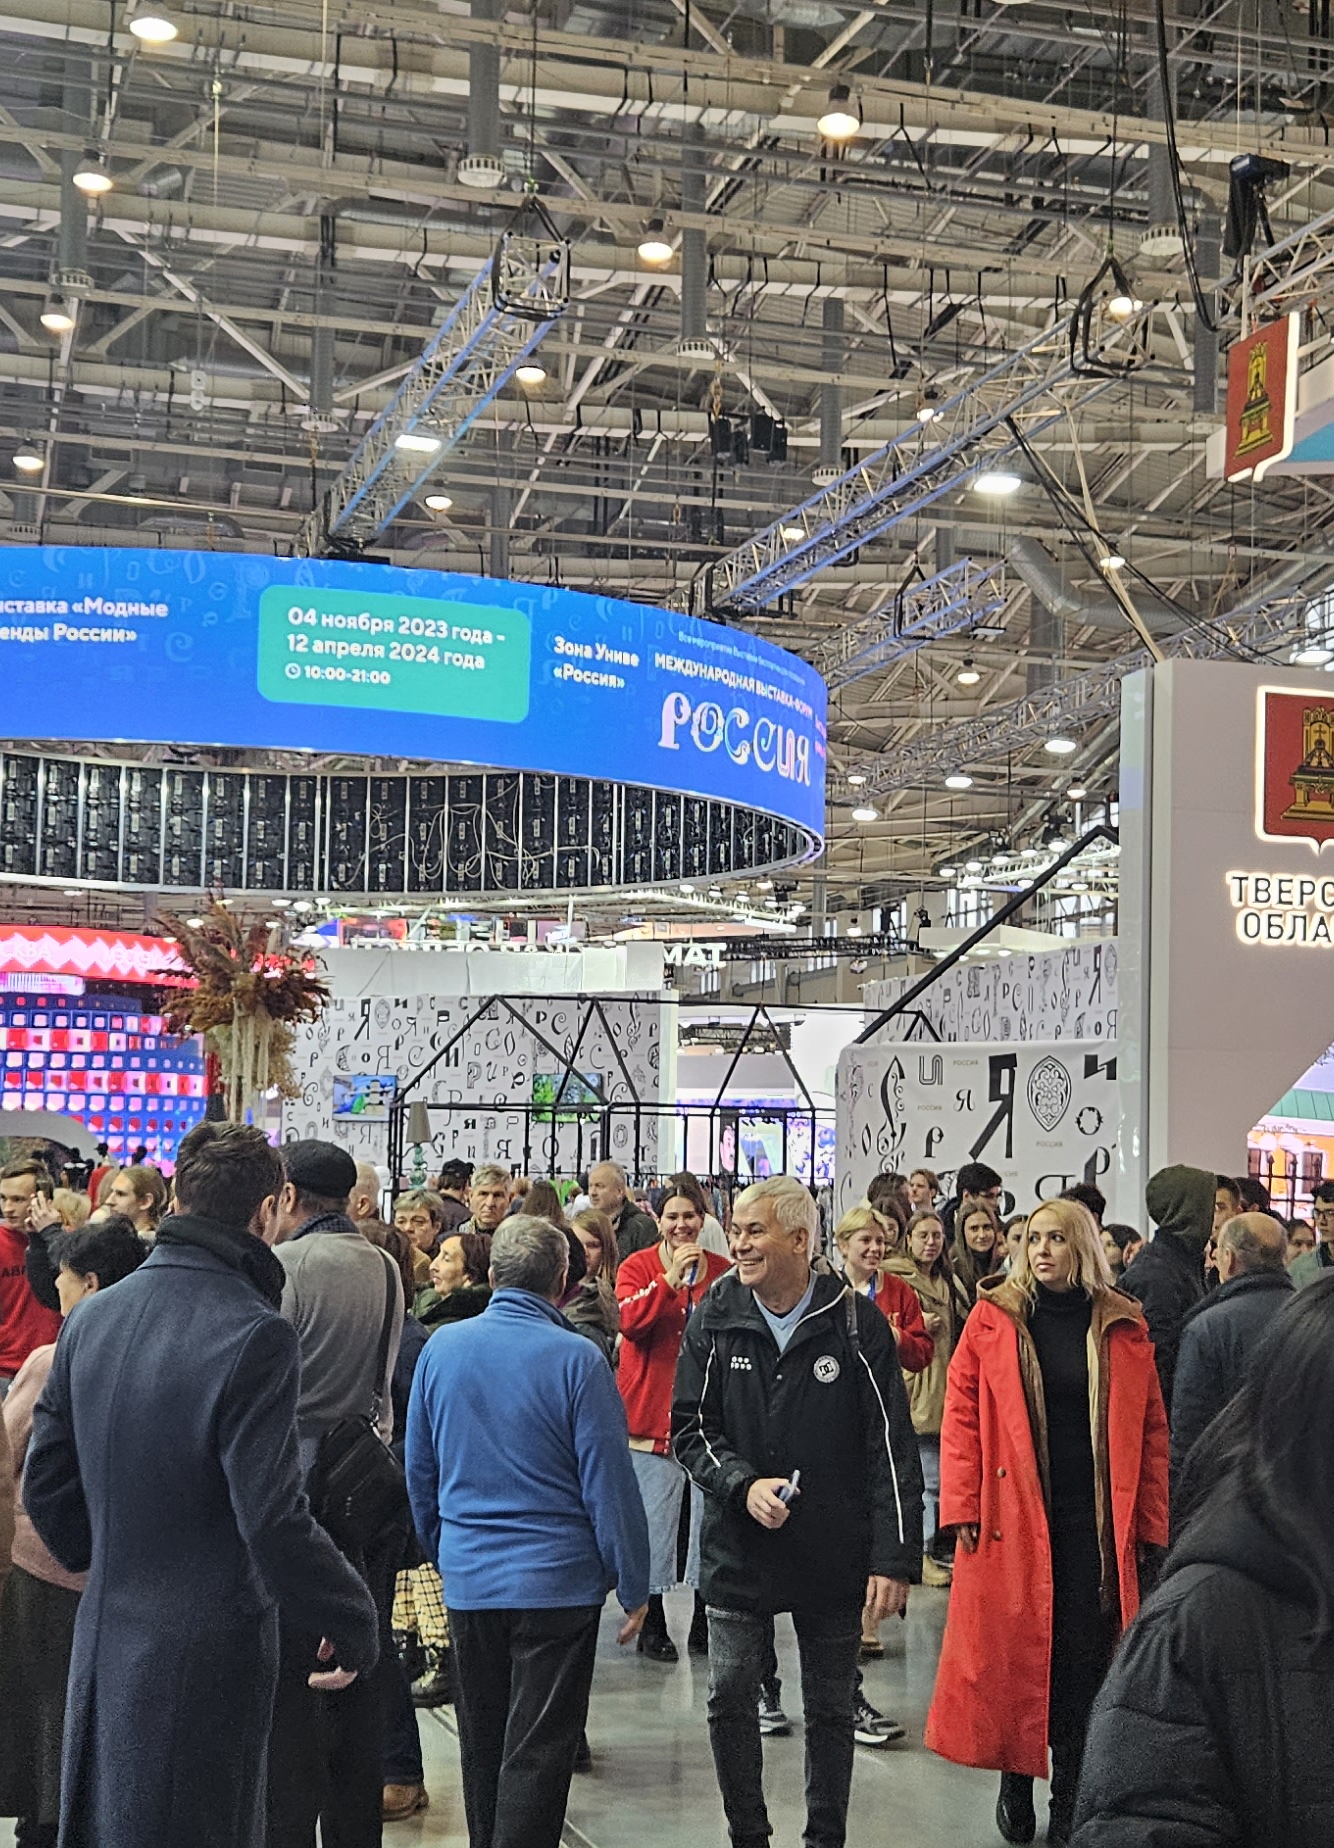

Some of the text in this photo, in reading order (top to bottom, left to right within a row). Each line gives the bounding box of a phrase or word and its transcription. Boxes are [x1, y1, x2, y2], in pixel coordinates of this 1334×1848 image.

[71, 596, 169, 618] «Модные
[53, 623, 138, 643] России»
[287, 607, 317, 627] 04
[321, 611, 395, 635] ноября
[398, 616, 448, 639] 2023
[451, 625, 494, 646] года
[287, 633, 486, 671] 12 апреля 2024 года
[553, 635, 593, 659] Зона
[304, 665, 391, 685] 10:00-21:00
[553, 663, 626, 689] «Россия»
[655, 652, 755, 694] МЕЖДУНАРОДНАЯ
[658, 691, 811, 788] РОССИЯ
